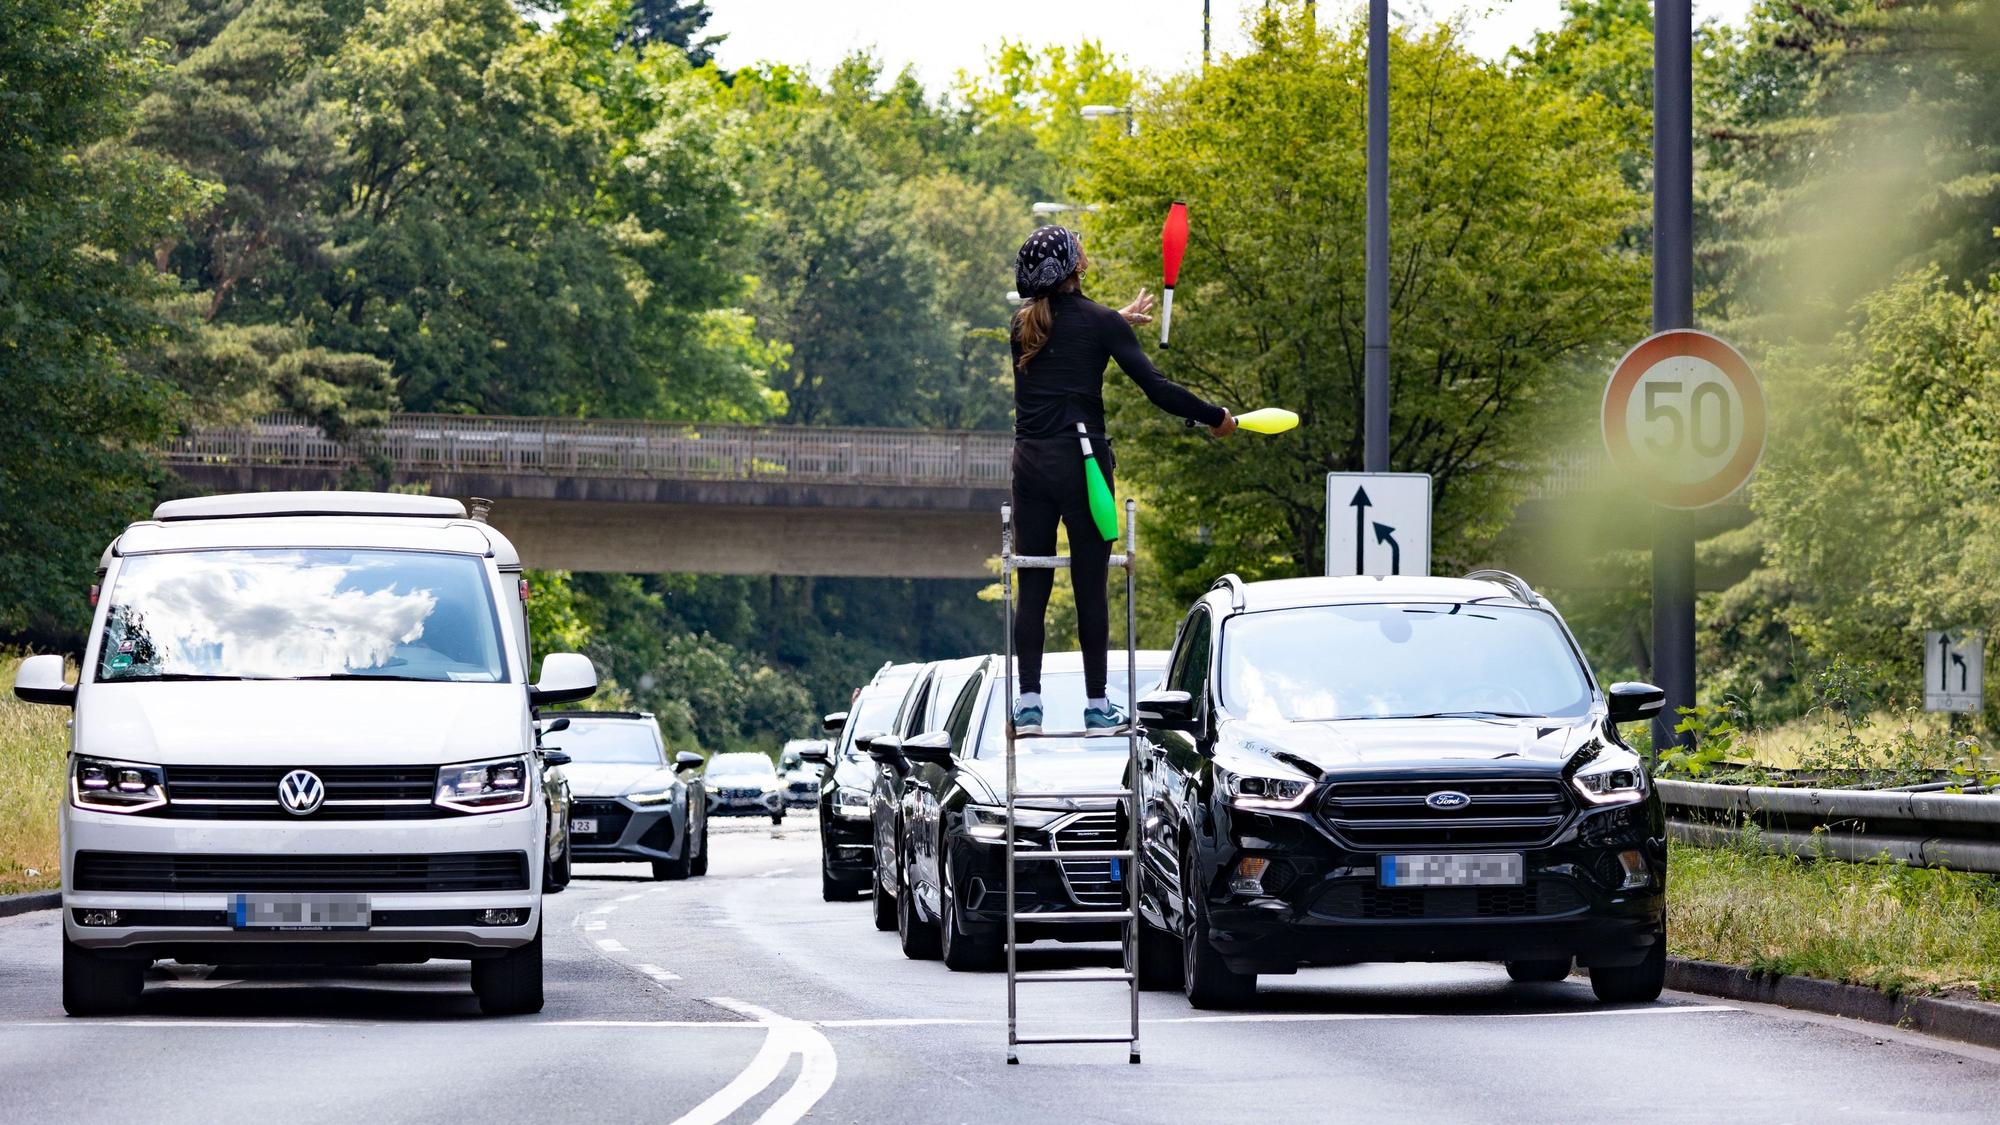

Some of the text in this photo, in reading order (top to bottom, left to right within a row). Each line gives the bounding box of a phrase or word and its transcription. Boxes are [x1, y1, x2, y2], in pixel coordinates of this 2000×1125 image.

[1644, 381, 1730, 459] 50
[281, 772, 320, 809] VW
[1436, 794, 1462, 805] Ford
[577, 821, 590, 831] 23
